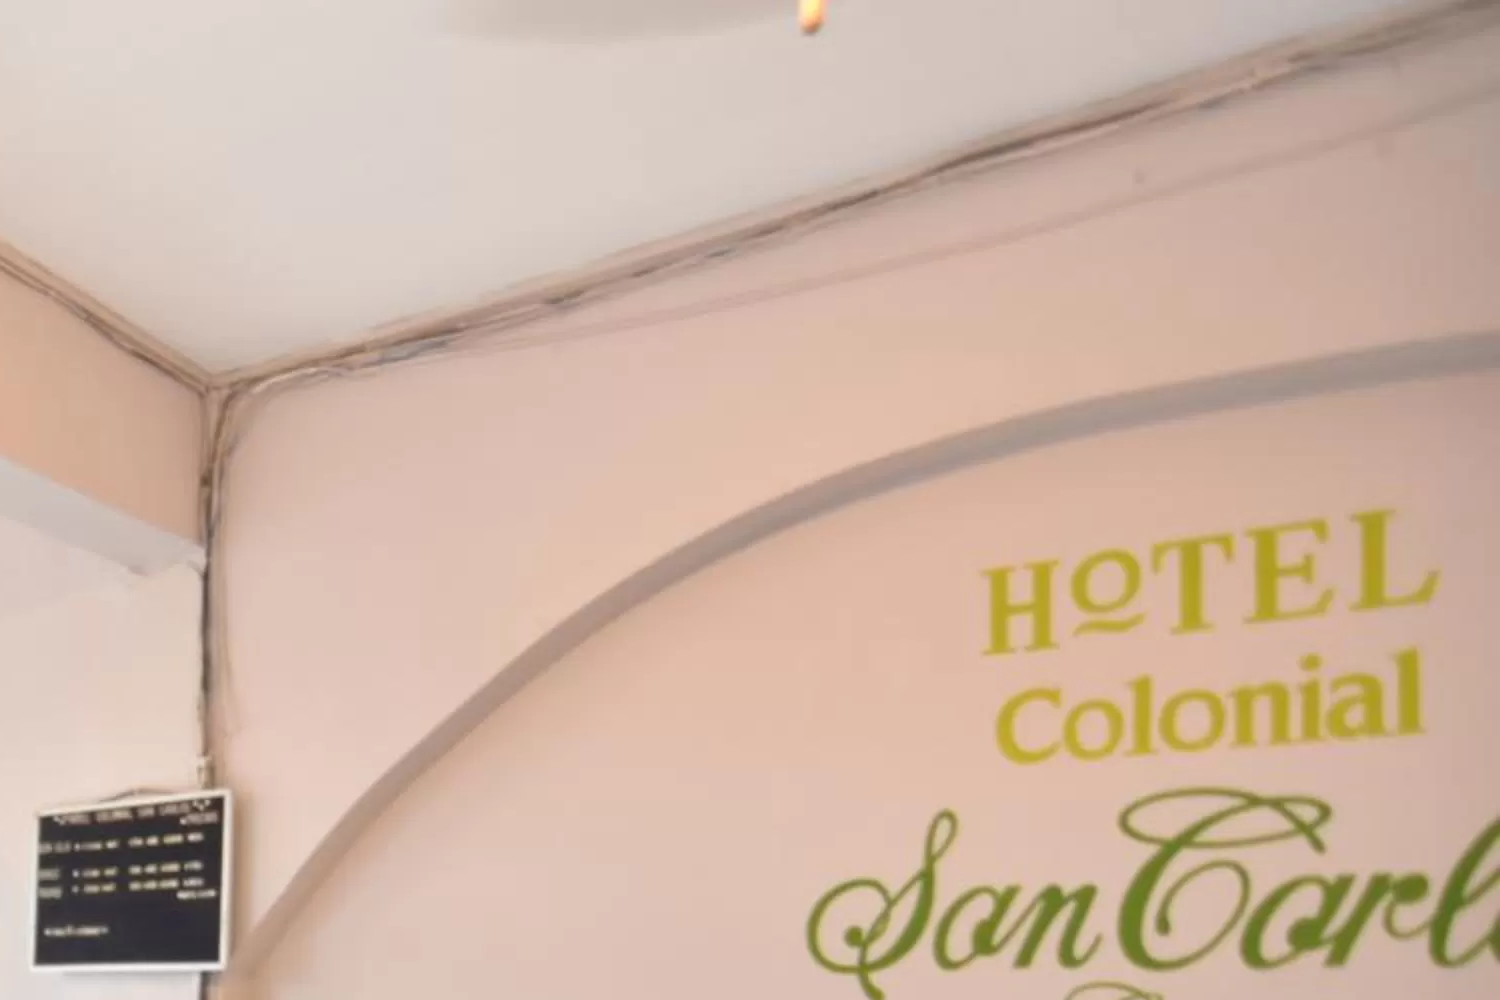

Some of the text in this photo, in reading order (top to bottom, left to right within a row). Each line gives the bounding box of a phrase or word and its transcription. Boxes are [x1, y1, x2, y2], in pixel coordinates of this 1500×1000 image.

[979, 507, 1442, 656] HOTEL
[994, 646, 1427, 766] Colonial
[1115, 785, 1500, 972] Carl
